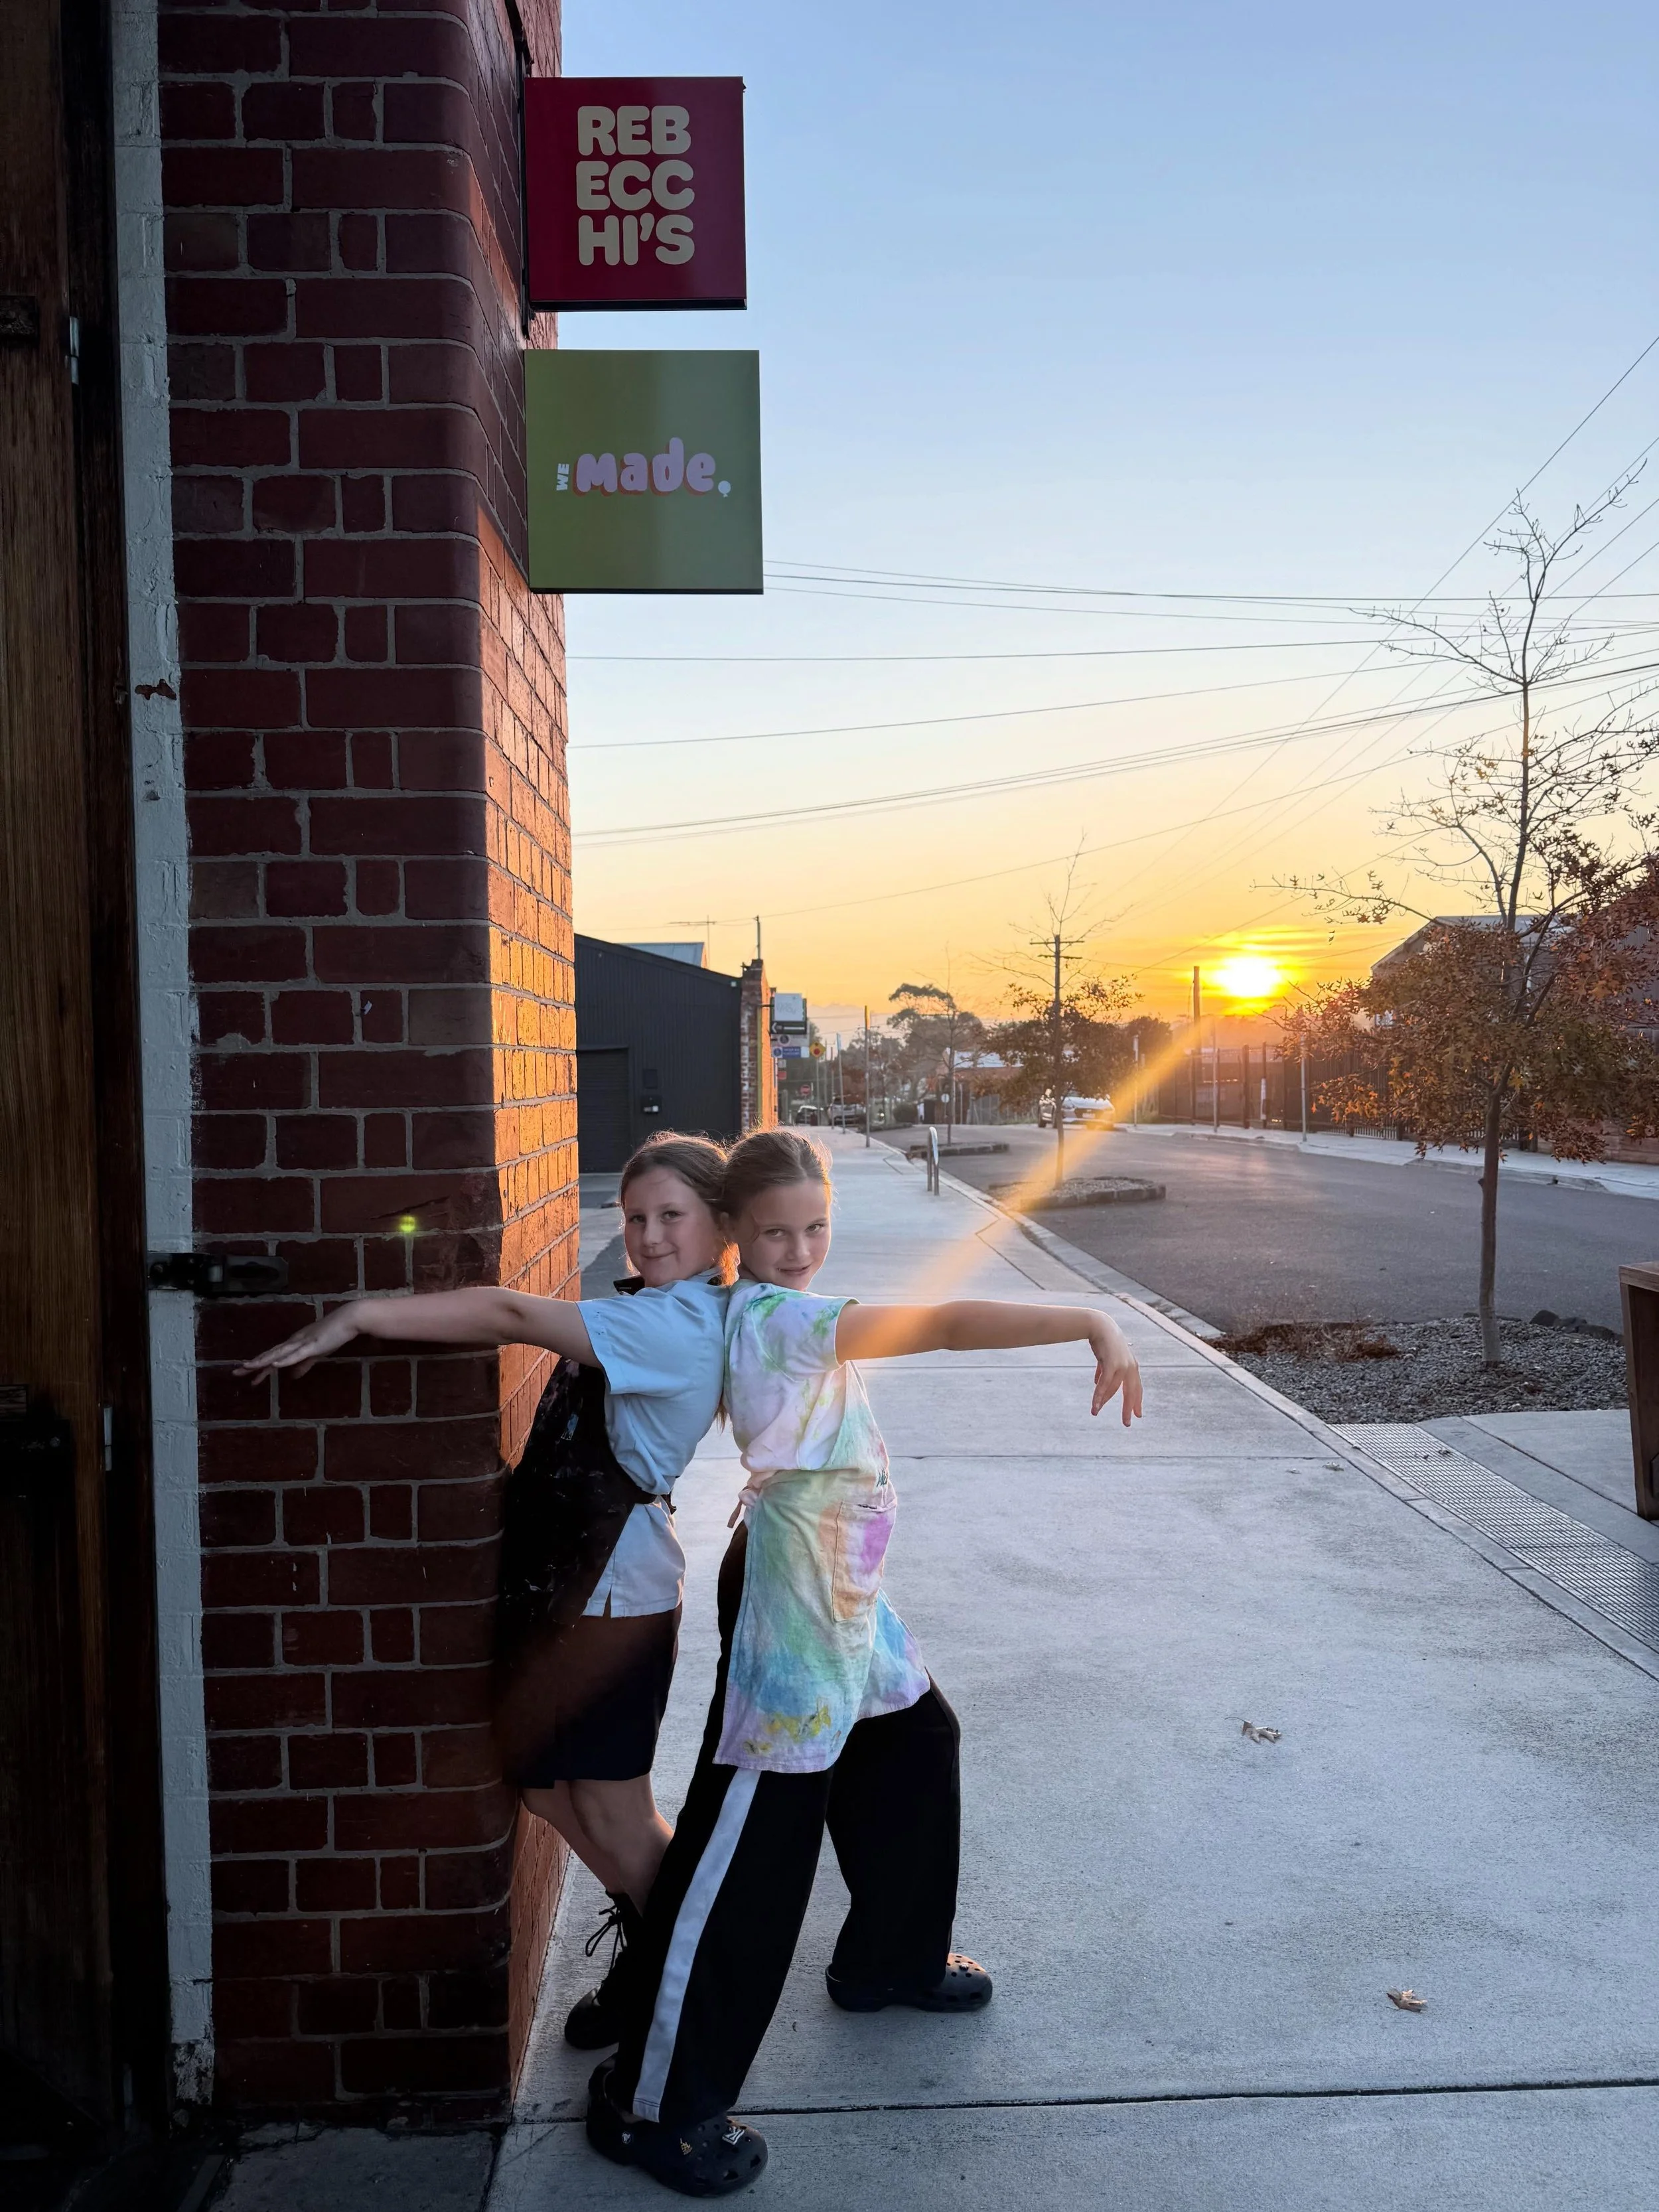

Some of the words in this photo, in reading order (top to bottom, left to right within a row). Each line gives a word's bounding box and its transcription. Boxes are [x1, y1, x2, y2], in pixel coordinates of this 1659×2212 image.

[577, 105, 691, 156] REB
[575, 159, 695, 211] ECC
[578, 212, 695, 266] HI'S
[556, 463, 569, 490] WE
